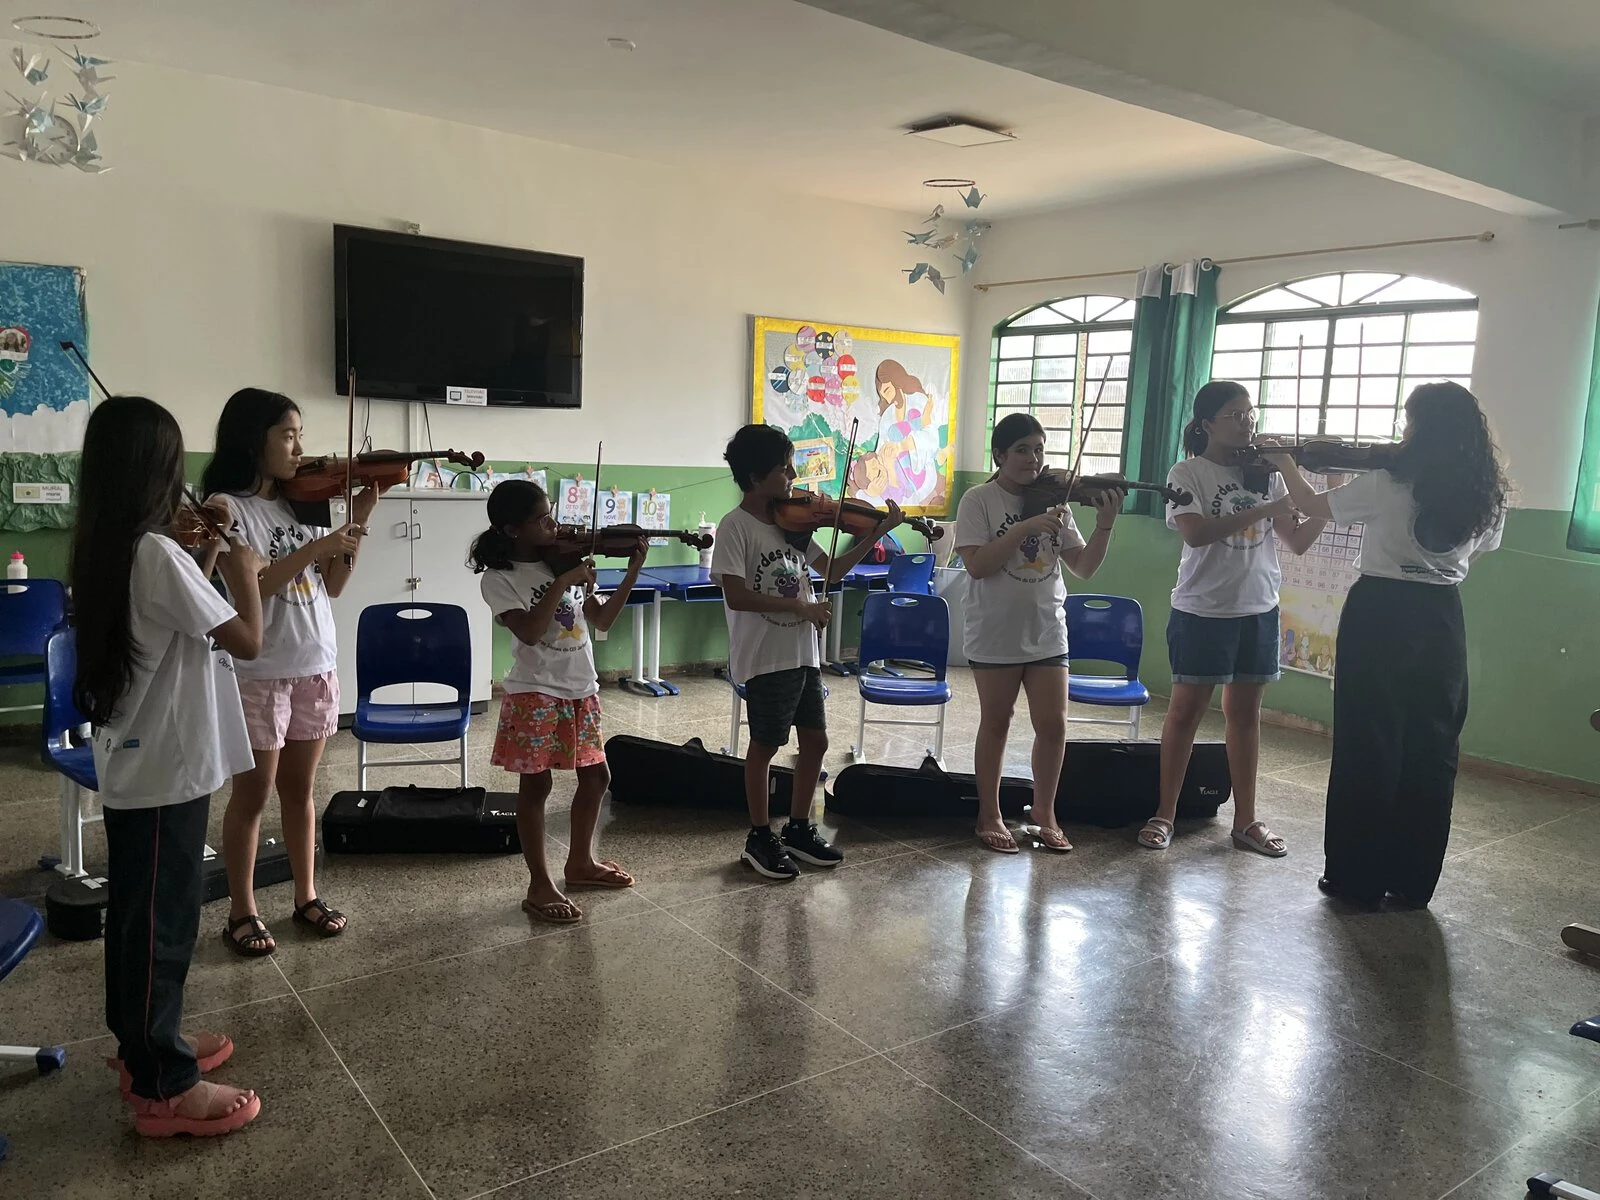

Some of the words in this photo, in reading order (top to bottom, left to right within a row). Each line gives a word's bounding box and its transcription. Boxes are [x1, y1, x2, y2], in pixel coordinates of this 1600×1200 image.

[567, 486, 578, 504] 8
[1211, 482, 1240, 518] cordes
[605, 498, 616, 514] 9
[642, 500, 657, 516] 10
[996, 512, 1023, 538] orde
[753, 549, 783, 593] cordes
[218, 657, 233, 672] Obra
